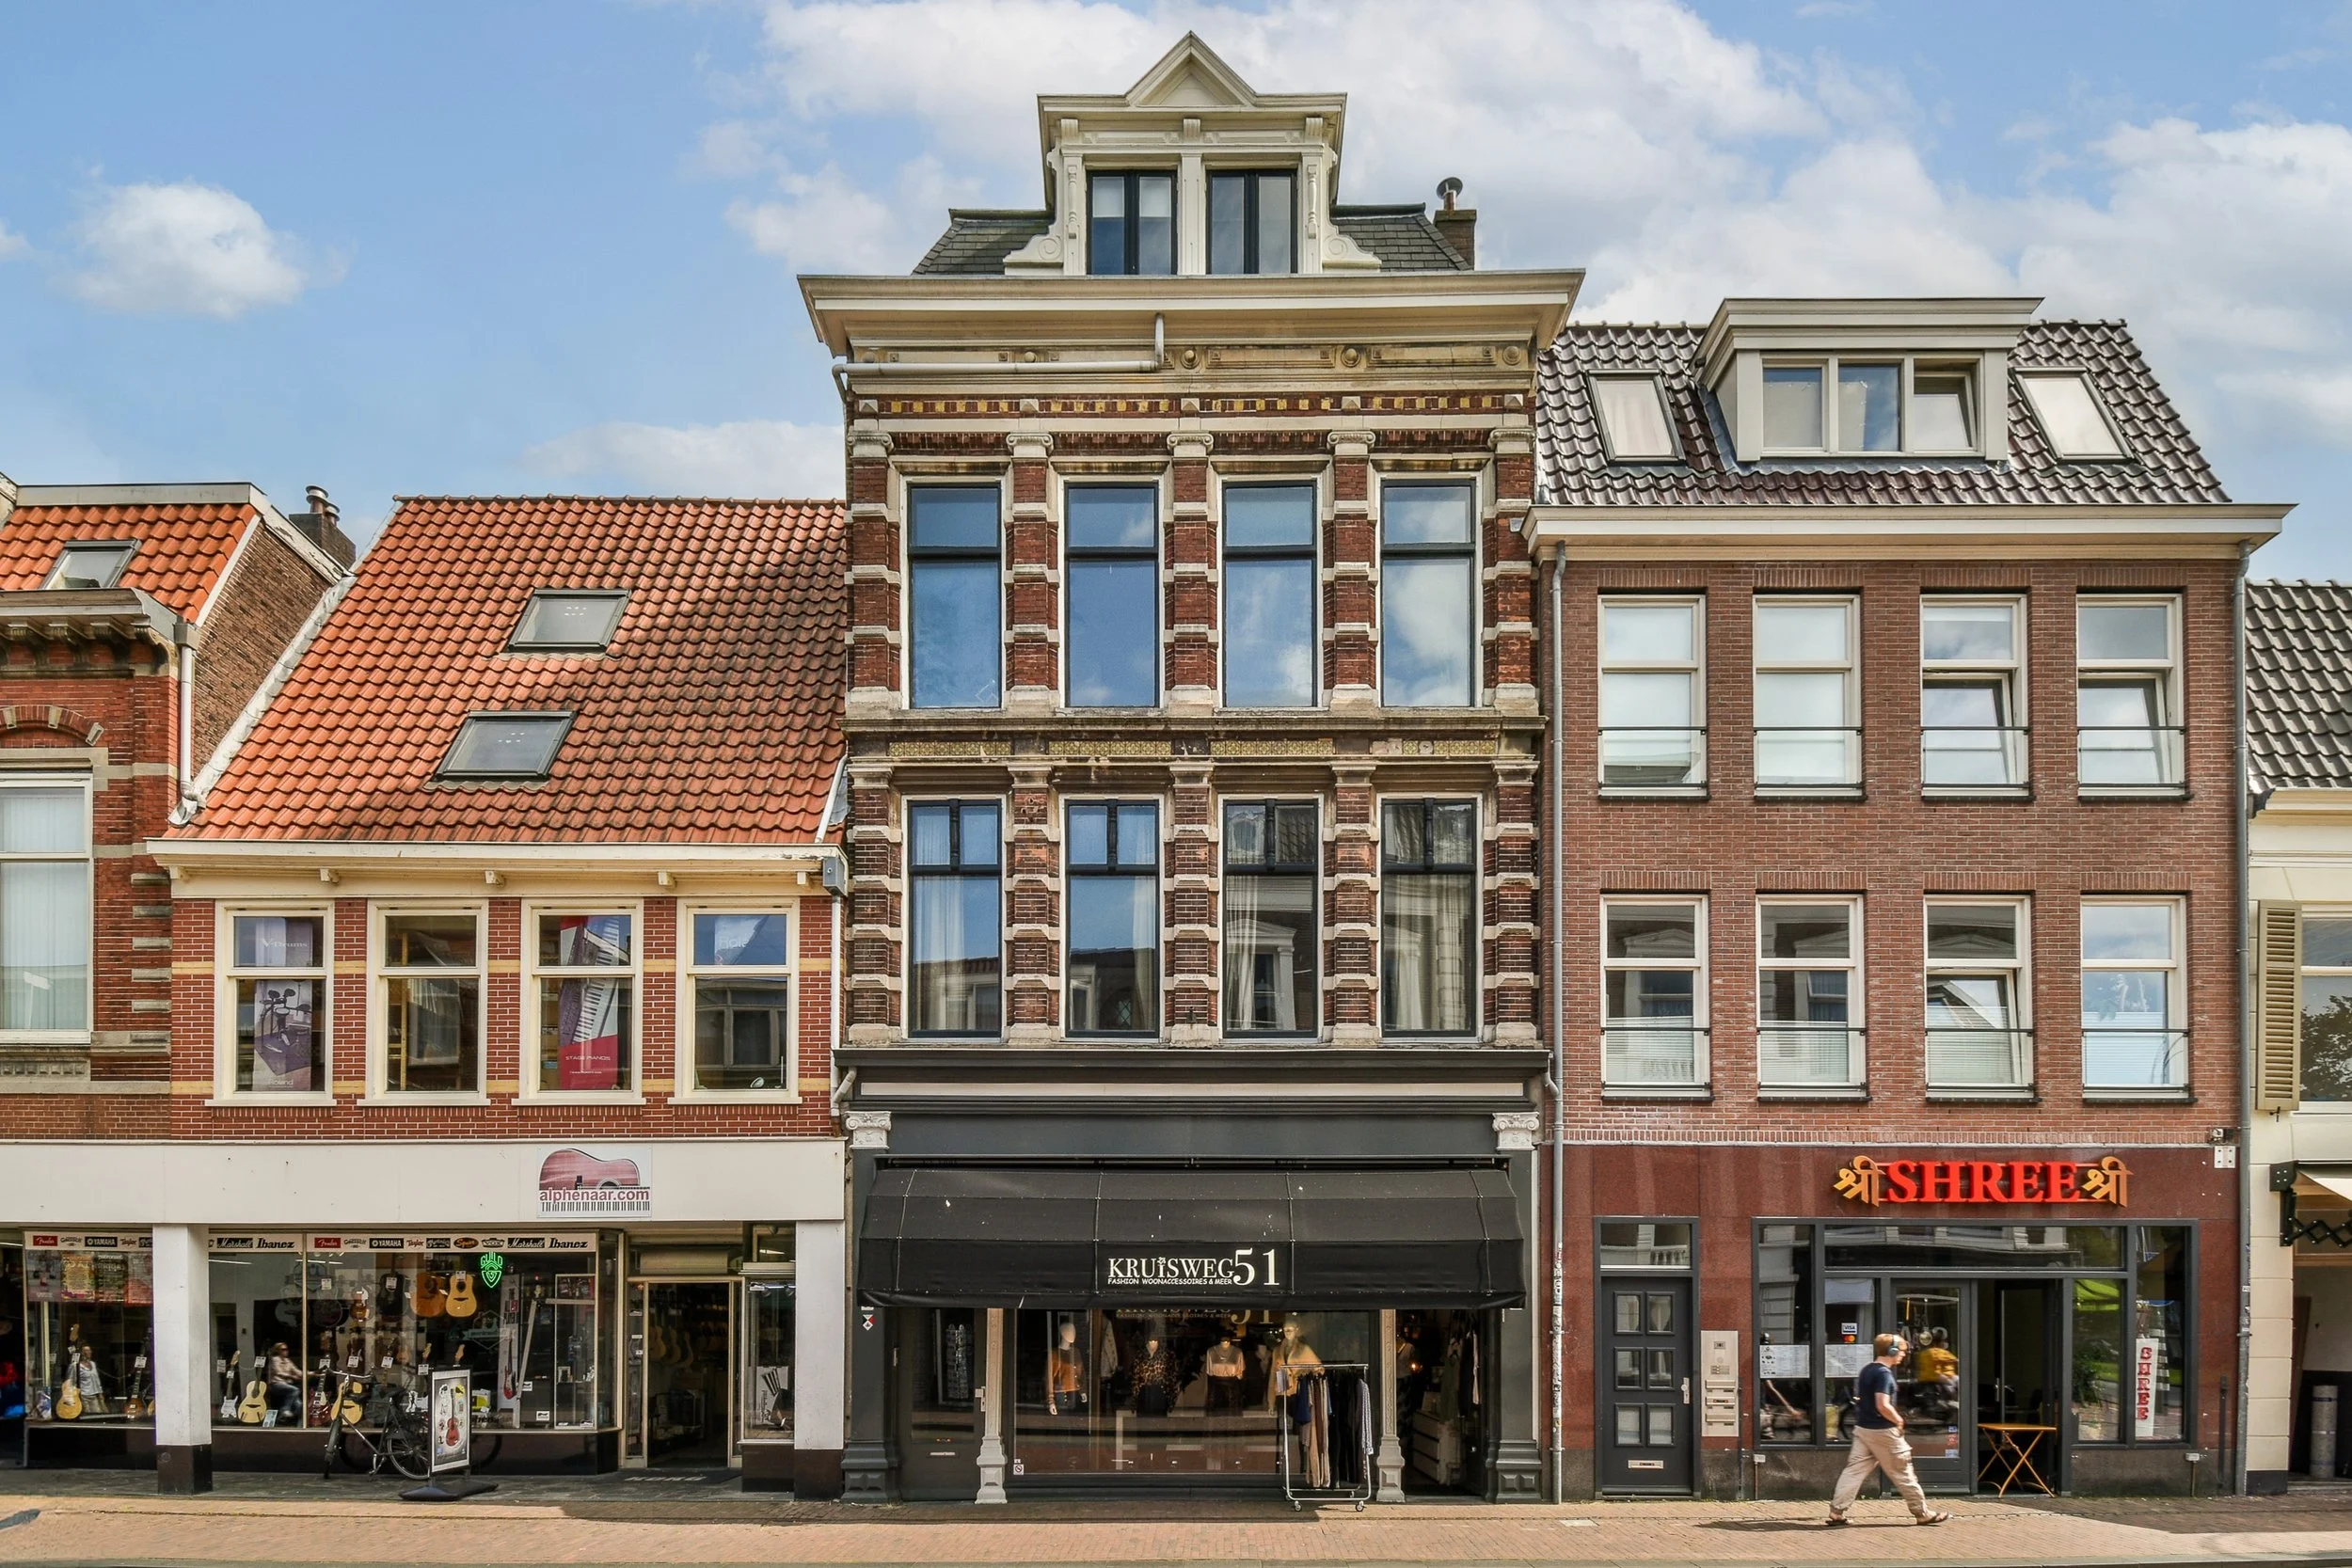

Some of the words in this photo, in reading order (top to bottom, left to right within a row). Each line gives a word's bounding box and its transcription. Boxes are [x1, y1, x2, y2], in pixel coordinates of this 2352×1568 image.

[1886, 1159, 2081, 1204] SHREE
[539, 1187, 649, 1204] alphenaar.com
[93, 1238, 116, 1246] YAMAHA
[217, 1237, 253, 1248] Marshall
[256, 1237, 294, 1248] Ibanez
[378, 1239, 403, 1247] YAMAHA
[406, 1239, 424, 1248] Taylor
[508, 1237, 545, 1248] Marshall
[548, 1237, 588, 1248] Ibanez
[481, 1252, 503, 1266] GUILD
[1232, 1247, 1280, 1286] 51
[2137, 1346, 2153, 1421] SHREE
